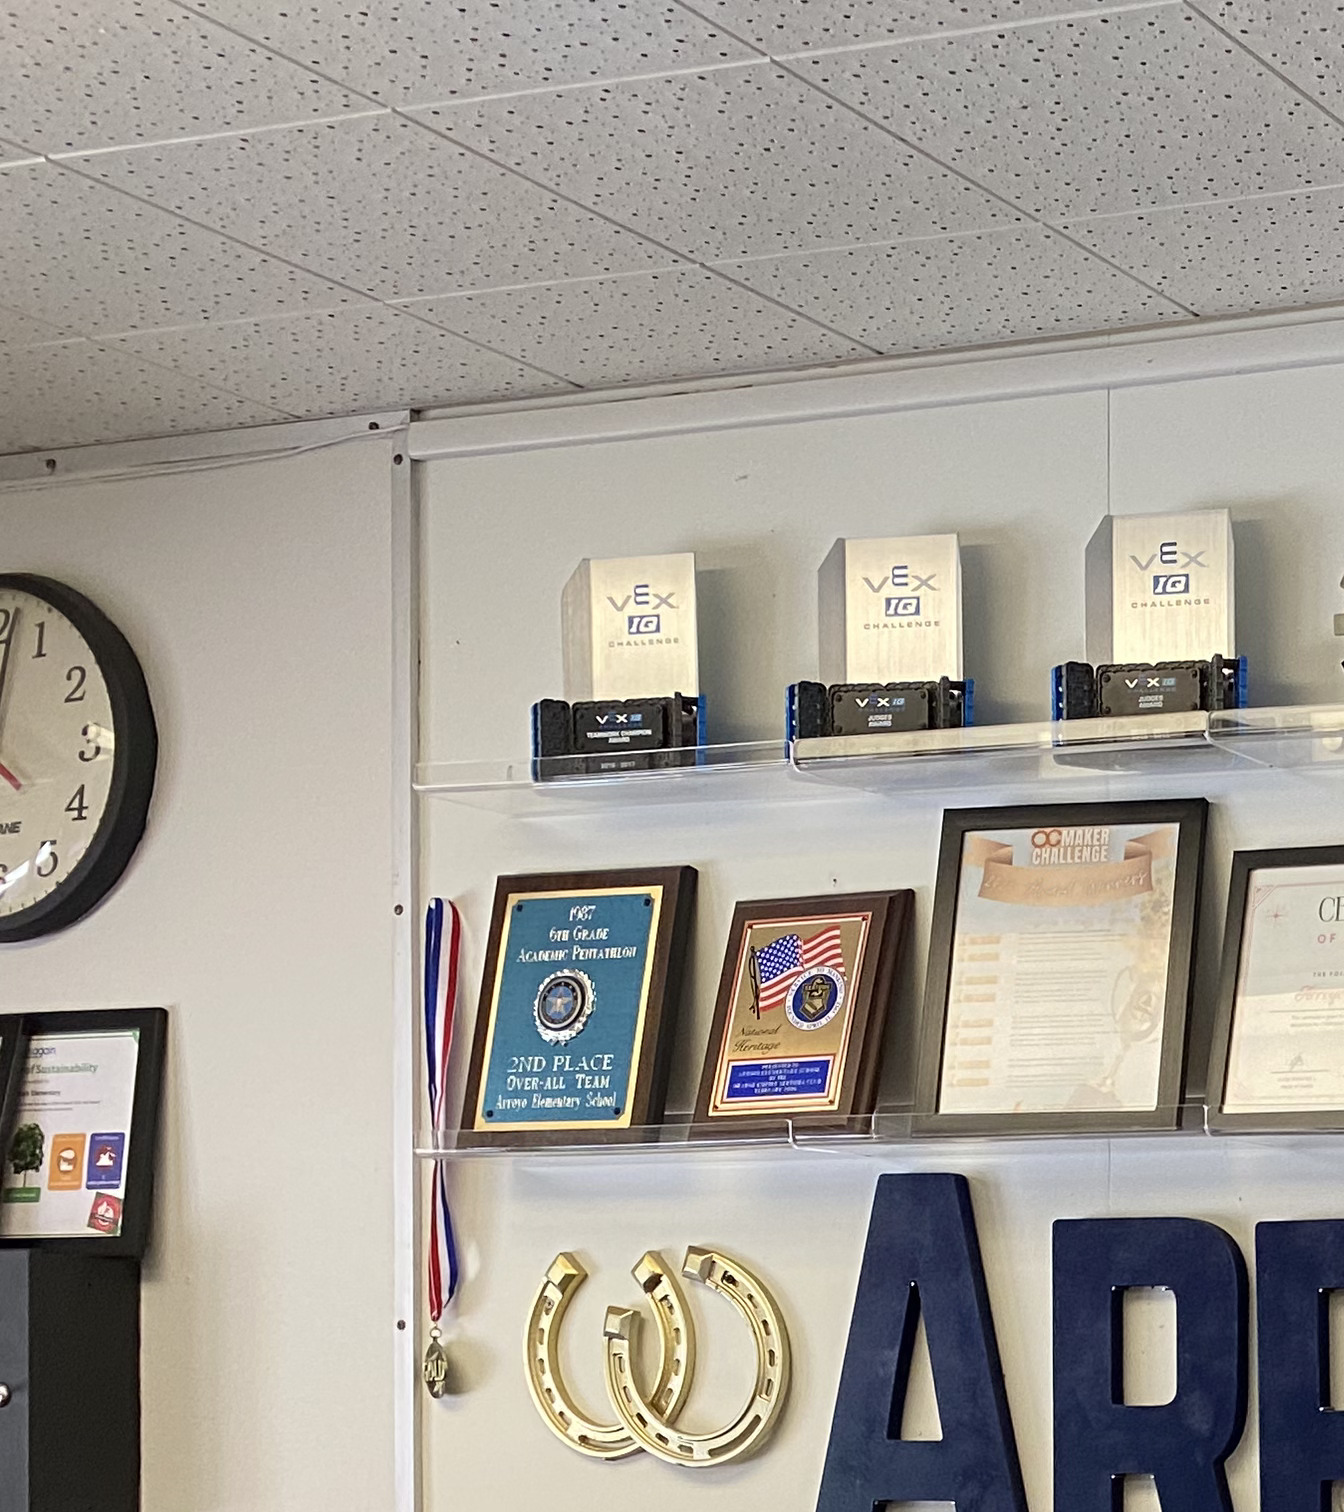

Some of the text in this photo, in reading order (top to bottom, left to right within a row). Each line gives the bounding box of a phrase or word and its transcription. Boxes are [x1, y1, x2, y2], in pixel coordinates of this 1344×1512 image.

[1130, 541, 1208, 571] VEX
[862, 565, 939, 593] VEX
[1154, 575, 1188, 594] IQ
[606, 584, 678, 612] VEX
[886, 597, 919, 615] IQ
[1131, 598, 1210, 609] CHALLENGE
[629, 616, 660, 634] IQ
[864, 620, 940, 630] CHALLENGE
[31, 621, 47, 659] 1
[609, 637, 680, 648] CHALLENGE
[64, 665, 86, 703] 2
[64, 784, 89, 821] 4
[36, 839, 59, 877] 5
[1031, 845, 1109, 865] CHALLENGE
[569, 905, 596, 921] 1987
[1317, 933, 1337, 944] OF
[507, 1054, 614, 1072] 2ND PLACE
[575, 1073, 610, 1089] TEAM
[496, 1091, 617, 1110] Arroyo Elementary School
